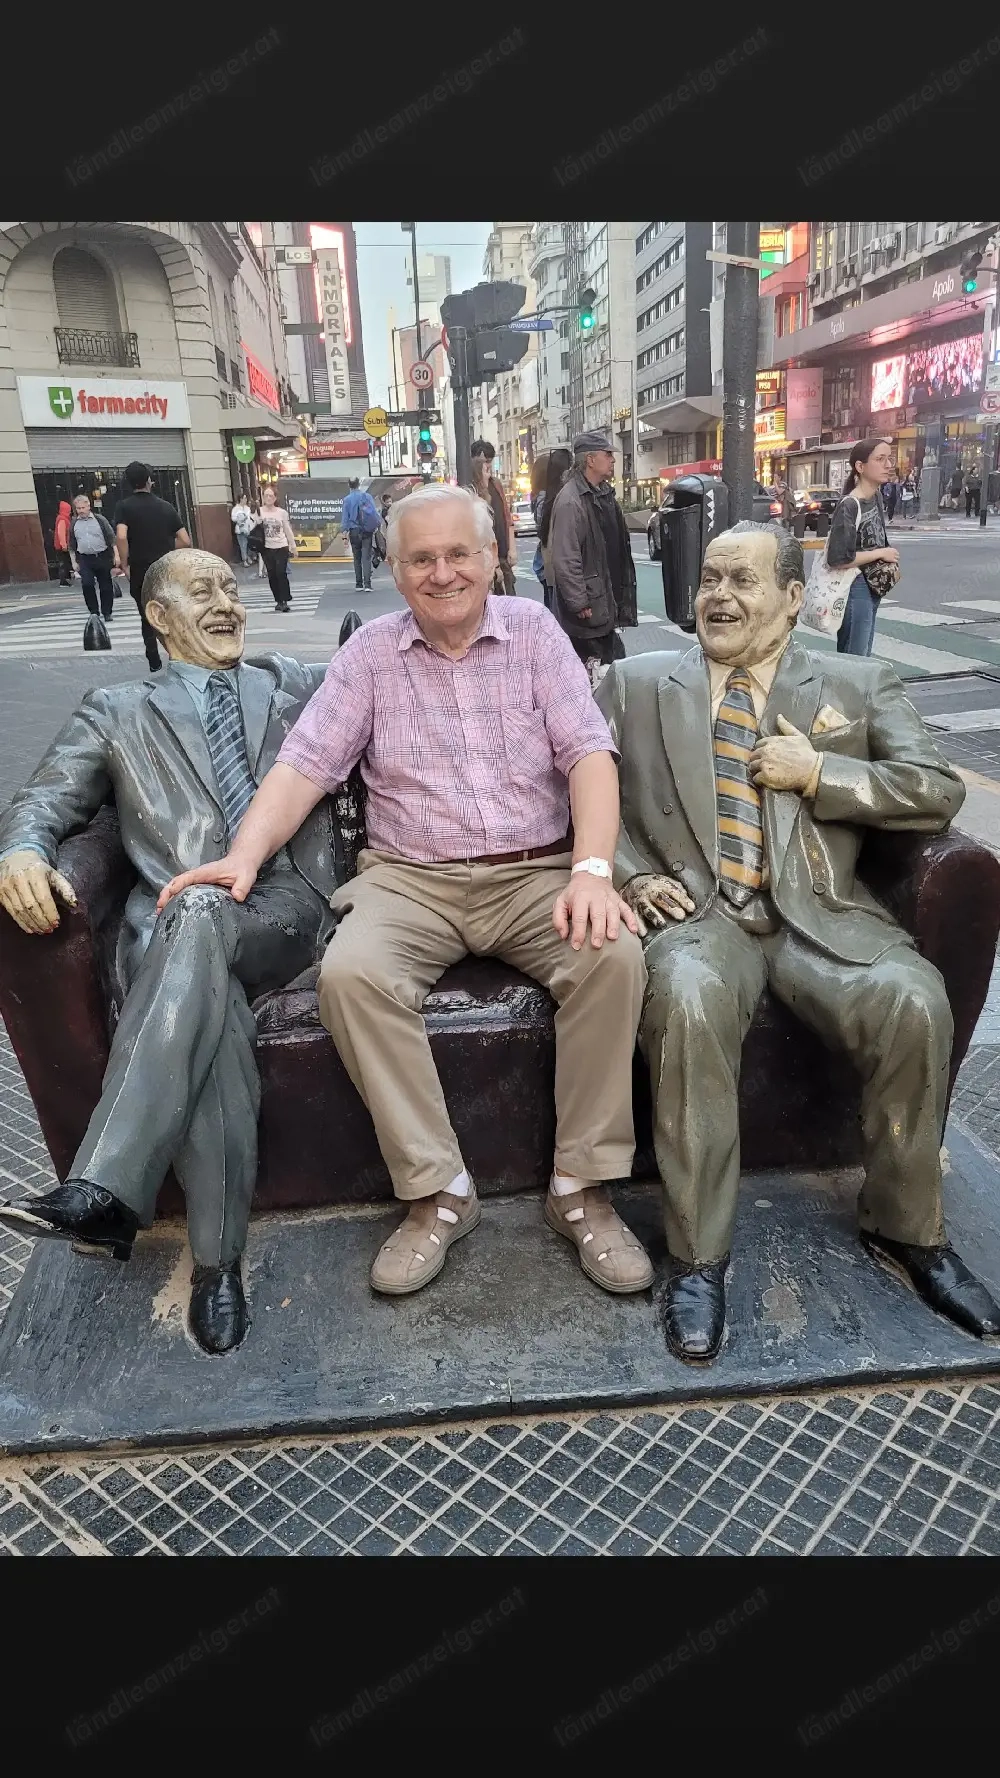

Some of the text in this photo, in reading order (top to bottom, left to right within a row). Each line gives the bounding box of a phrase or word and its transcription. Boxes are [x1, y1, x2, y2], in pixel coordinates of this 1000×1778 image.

[286, 250, 311, 260] LOS
[932, 274, 955, 301] Apolo
[323, 260, 346, 400] INMORTALES
[829, 317, 845, 340] Apolo
[415, 369, 429, 380] 30
[77, 389, 168, 419] farmacity
[789, 386, 816, 403] Apolo
[289, 506, 312, 514] Integral
